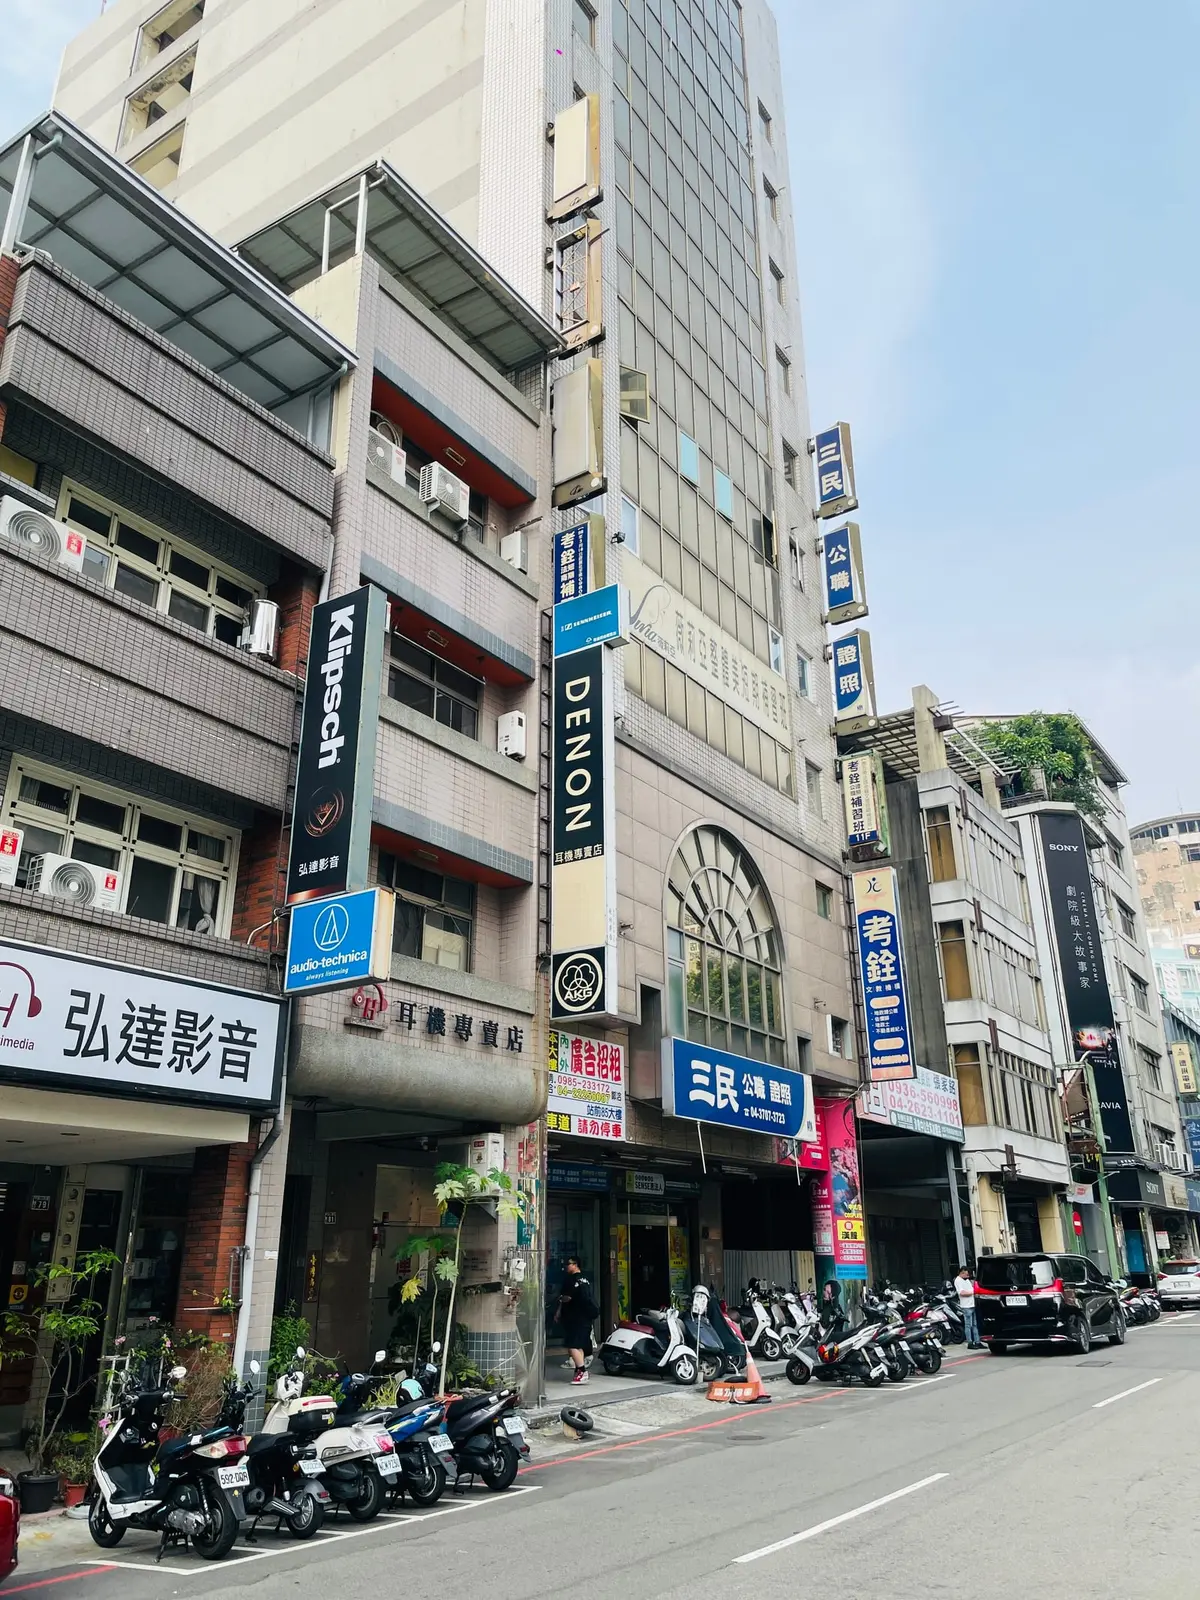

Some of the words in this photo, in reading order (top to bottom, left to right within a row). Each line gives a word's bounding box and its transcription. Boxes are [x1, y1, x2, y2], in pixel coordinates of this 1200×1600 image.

[818, 442, 842, 496] 三民
[560, 531, 575, 567] 考銓
[828, 546, 850, 592] 公職
[560, 579, 575, 602] 補
[836, 645, 861, 695] 證照
[318, 604, 355, 769] Klipsch
[565, 676, 591, 832] DENON
[848, 761, 860, 785] 考銓
[851, 796, 865, 832] 補習班
[855, 832, 871, 842] 11F
[1049, 843, 1079, 852] SONY
[554, 843, 603, 864] 耳機專賣店
[299, 855, 340, 877] 弘達影音
[863, 915, 898, 983] 考銓
[1066, 885, 1091, 989] 劇院級大故事家
[290, 949, 367, 975] audio-technica
[305, 972, 324, 981] always
[325, 966, 349, 978] listening
[564, 987, 593, 1000] AKG
[63, 989, 257, 1082] 弘達影音
[394, 1000, 524, 1052] 耳機專賣店
[0, 1034, 35, 1050] imedia
[570, 1037, 621, 1082] 廣告招租
[557, 1074, 611, 1093] 0985-233172
[689, 1059, 740, 1113] 三民
[742, 1073, 766, 1100] 公職
[769, 1080, 792, 1106] 證照
[750, 1106, 785, 1125] 04-3707-3723
[1098, 1101, 1121, 1110] AVIA
[547, 1112, 570, 1131] 車道
[577, 1117, 622, 1138] 請勿停車
[1145, 1181, 1160, 1195] SONY
